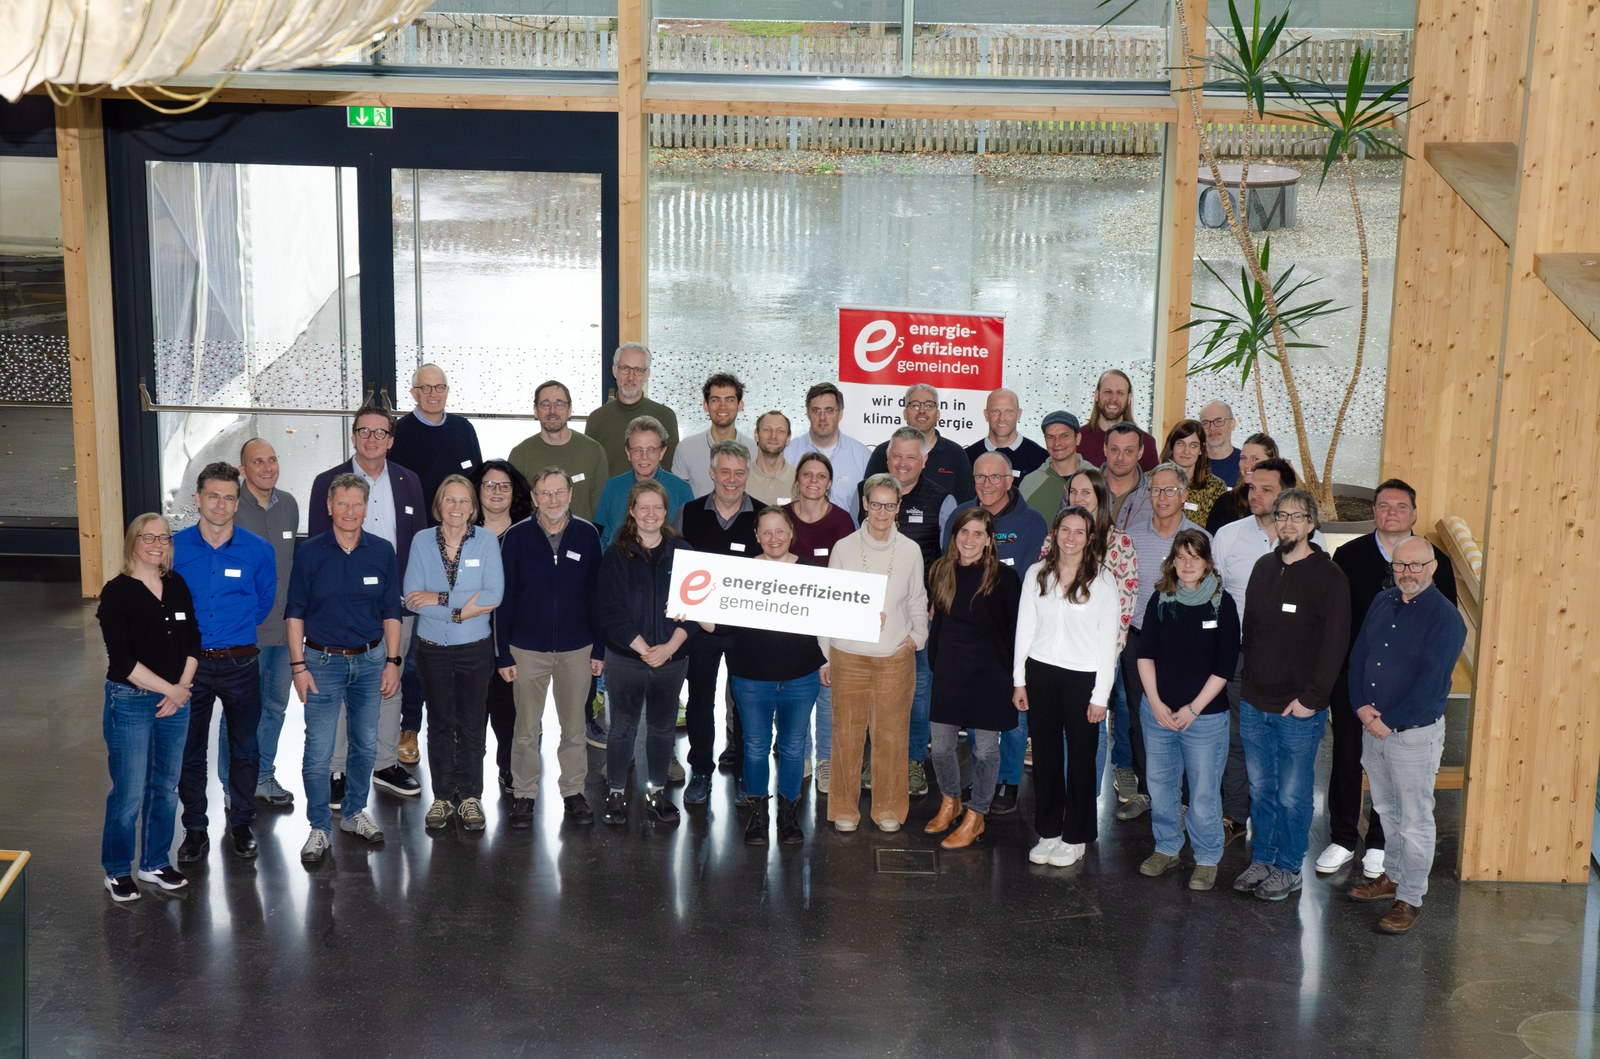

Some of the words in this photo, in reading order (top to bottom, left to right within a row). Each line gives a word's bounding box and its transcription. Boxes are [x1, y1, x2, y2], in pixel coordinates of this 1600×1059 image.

[909, 323, 977, 339] energie-
[912, 342, 989, 358] effiziente
[897, 359, 979, 375] gemeinden
[872, 395, 893, 407] wir
[953, 399, 966, 411] in
[863, 413, 901, 425] klima
[934, 417, 974, 431] ergie
[722, 576, 871, 605] energieeffiziente
[719, 596, 810, 617] gemeinden
